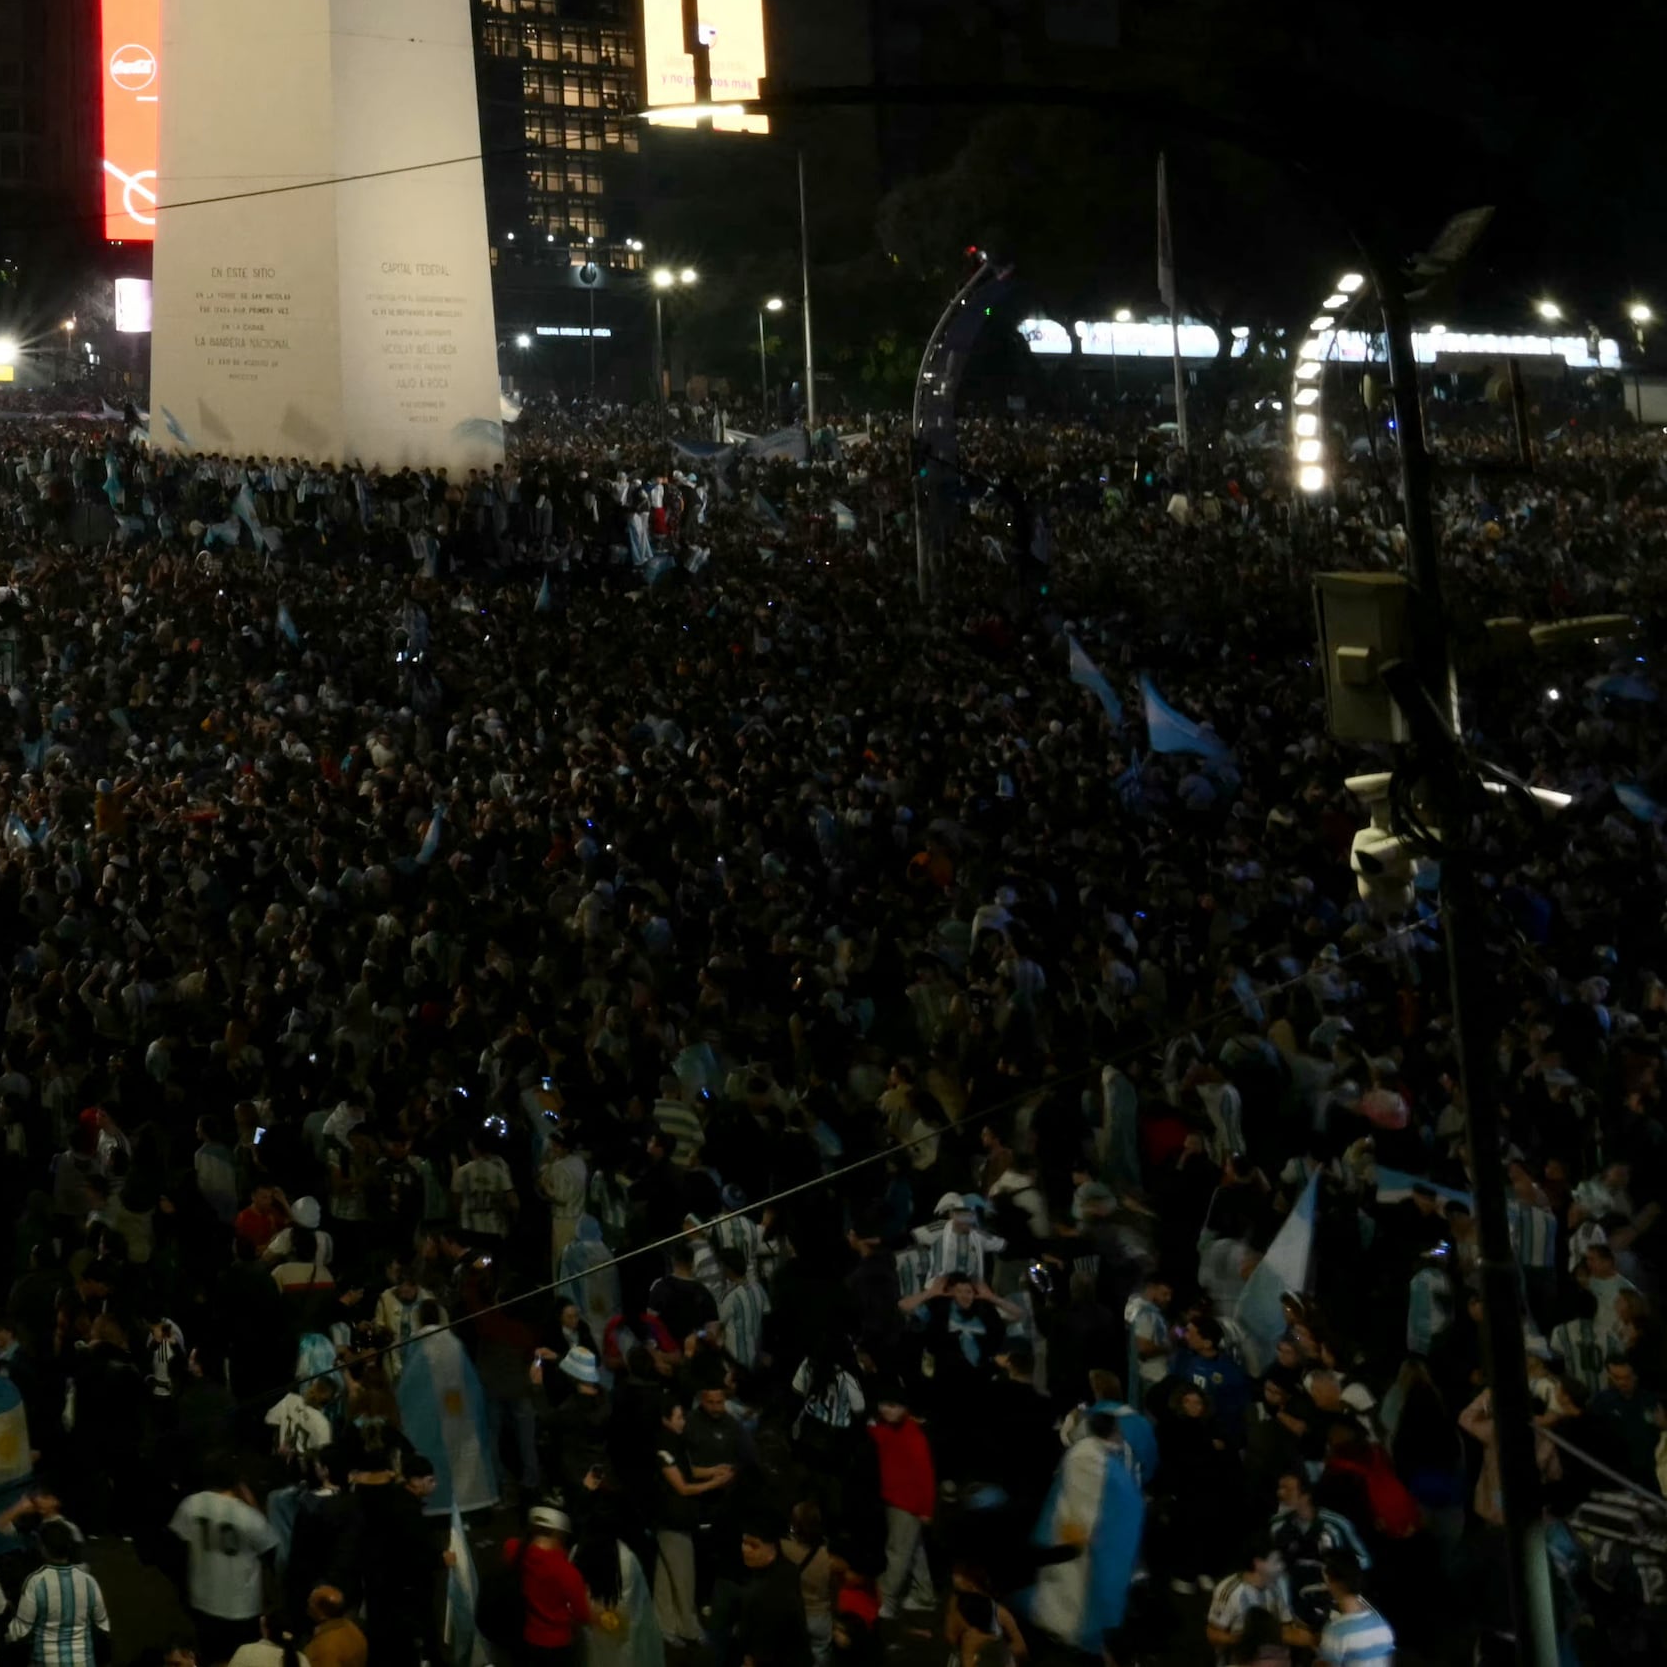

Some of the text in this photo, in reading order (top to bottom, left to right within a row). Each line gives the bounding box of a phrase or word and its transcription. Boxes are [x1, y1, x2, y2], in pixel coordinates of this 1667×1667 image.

[670, 74, 683, 84] no
[211, 267, 276, 278] EN ESTE SITIO
[197, 1517, 239, 1556] 10
